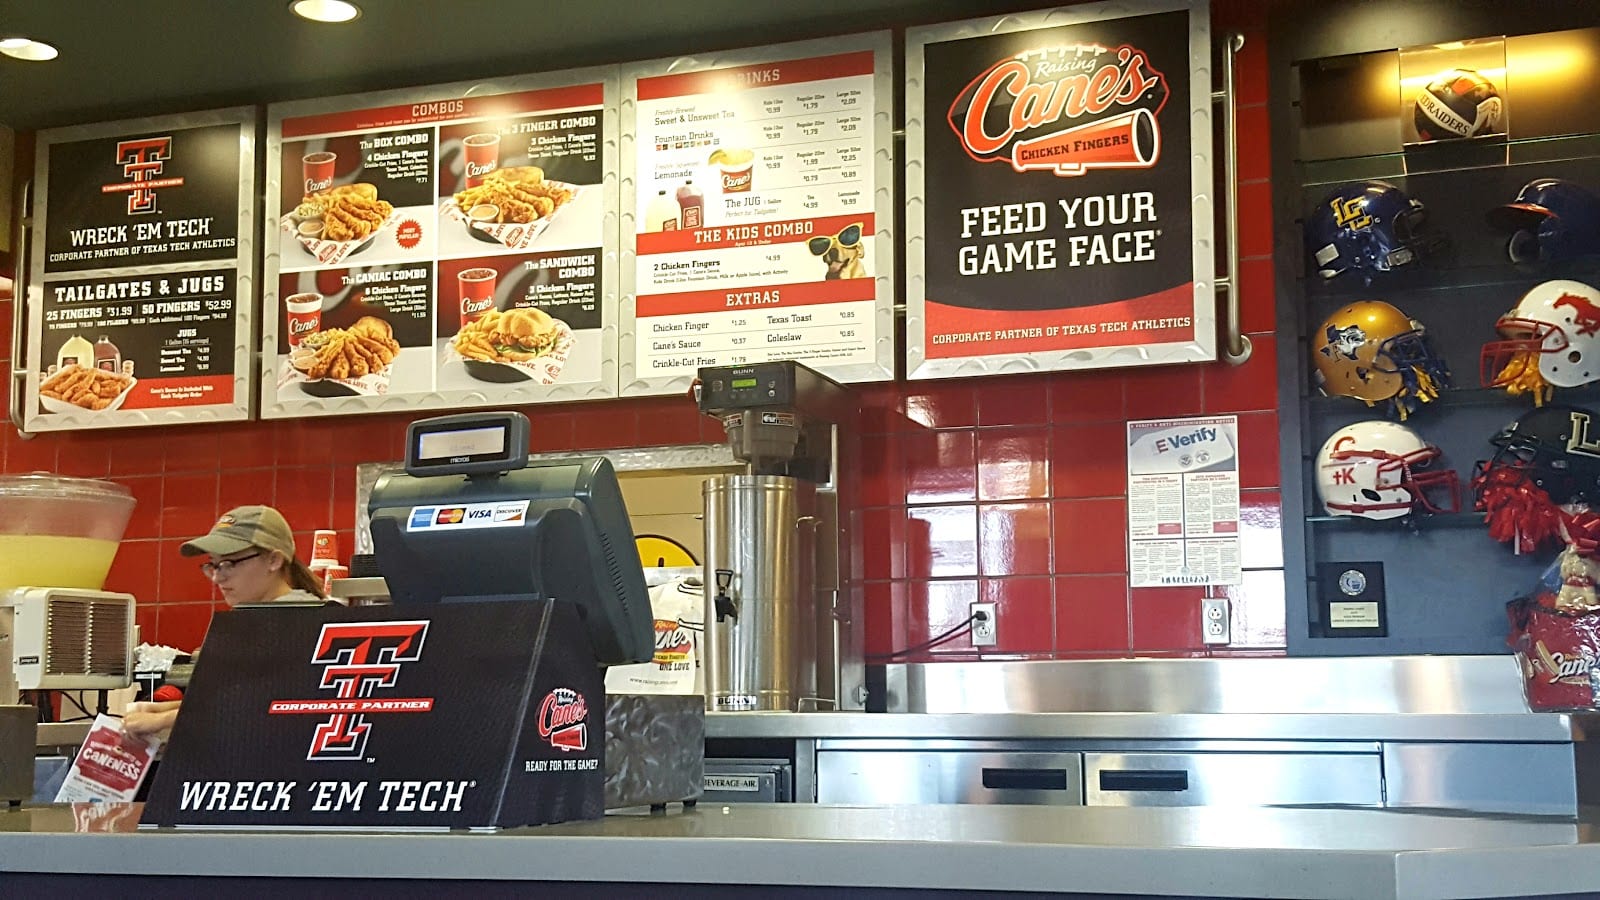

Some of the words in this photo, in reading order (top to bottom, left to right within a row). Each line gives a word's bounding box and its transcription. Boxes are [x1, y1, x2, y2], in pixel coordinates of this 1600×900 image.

[1035, 57, 1098, 79] Raising
[728, 69, 780, 86] RINKS
[964, 47, 1159, 154] Cane's
[412, 100, 464, 117] COMBOS
[520, 120, 558, 133] FINGER
[560, 116, 596, 129] COMBO
[655, 117, 677, 126] Sweet
[679, 114, 686, 123] &
[688, 112, 720, 122] Unsweet
[360, 141, 373, 150] The
[374, 136, 394, 149] BOX
[394, 133, 429, 146] COMBO
[538, 136, 567, 145] Chicken
[568, 134, 596, 142] Fingers
[654, 134, 686, 144] Fountain
[689, 130, 714, 140] Drinks
[1020, 143, 1070, 161] CHICKEN
[1074, 133, 1130, 152] FINGERS
[374, 152, 400, 161] Chicken
[402, 150, 429, 160] Fingers
[654, 170, 693, 180] Lemonade
[724, 199, 742, 208] The
[744, 196, 760, 206] JUG
[960, 202, 1047, 238] FEED
[1059, 192, 1158, 228] YOUR
[71, 225, 128, 246] WRECK
[132, 222, 162, 241] 'EM
[694, 230, 722, 244] THE
[726, 225, 760, 242] KIDS
[764, 221, 814, 238] COMBO
[50, 251, 92, 262] CORPORATE
[94, 248, 130, 259] PARTNER
[132, 246, 140, 256] OF
[143, 244, 168, 254] TEXAS
[170, 242, 190, 252] TECH
[192, 238, 236, 250] ATHLETICS
[958, 238, 1057, 276] GAME
[524, 261, 538, 270] The
[540, 254, 596, 269] SANDWICH
[661, 262, 690, 270] Chicken
[692, 260, 720, 269] Fingers
[356, 272, 392, 283] CANIAC
[393, 268, 427, 280] COMBO
[558, 266, 595, 279] COMBO
[55, 280, 152, 302] TAILGATES
[159, 279, 170, 296] &
[178, 276, 225, 294] JUGS
[372, 286, 399, 294] Chicken
[400, 284, 427, 294] Fingers
[536, 284, 566, 294] Chicken
[566, 282, 595, 292] Fingers
[460, 296, 493, 314] Cane's
[726, 290, 780, 307] EXTRAS
[46, 310, 58, 321] 25
[60, 307, 102, 320] FINGERS
[106, 306, 133, 317] $31.99
[142, 303, 154, 314] 50
[156, 300, 200, 314] FINGERS
[205, 299, 232, 310] $52.99
[289, 316, 319, 335] Cane's
[767, 315, 790, 324] Texas
[791, 314, 812, 324] Toast
[177, 328, 197, 338] JUGS
[652, 323, 683, 332] Chicken
[685, 322, 710, 332] Finger
[932, 330, 992, 345] CORPORATE
[994, 327, 1044, 341] PARTNER
[1046, 325, 1060, 336] OF
[1062, 323, 1097, 336] TEXAS
[1100, 321, 1128, 333] TECH
[1131, 316, 1191, 331] ATHLETICS
[652, 341, 678, 350] Cane's
[678, 340, 701, 349] Sauce
[767, 332, 802, 343] Coleslaw
[652, 358, 696, 368] Crinkle-Cut
[696, 356, 716, 366] Fries
[1156, 439, 1168, 453] E
[1168, 428, 1216, 449] Verify
[468, 510, 492, 518] VISA
[674, 662, 690, 671] LOVE
[271, 701, 356, 712] CORPORATE
[361, 700, 431, 711] PARTNER
[538, 693, 588, 737] Cane's
[525, 761, 548, 772] READY
[550, 760, 563, 771] FOR
[564, 760, 576, 770] THE
[578, 759, 599, 770] GAME?
[180, 781, 298, 812] WRECK
[308, 781, 368, 812] 'EM
